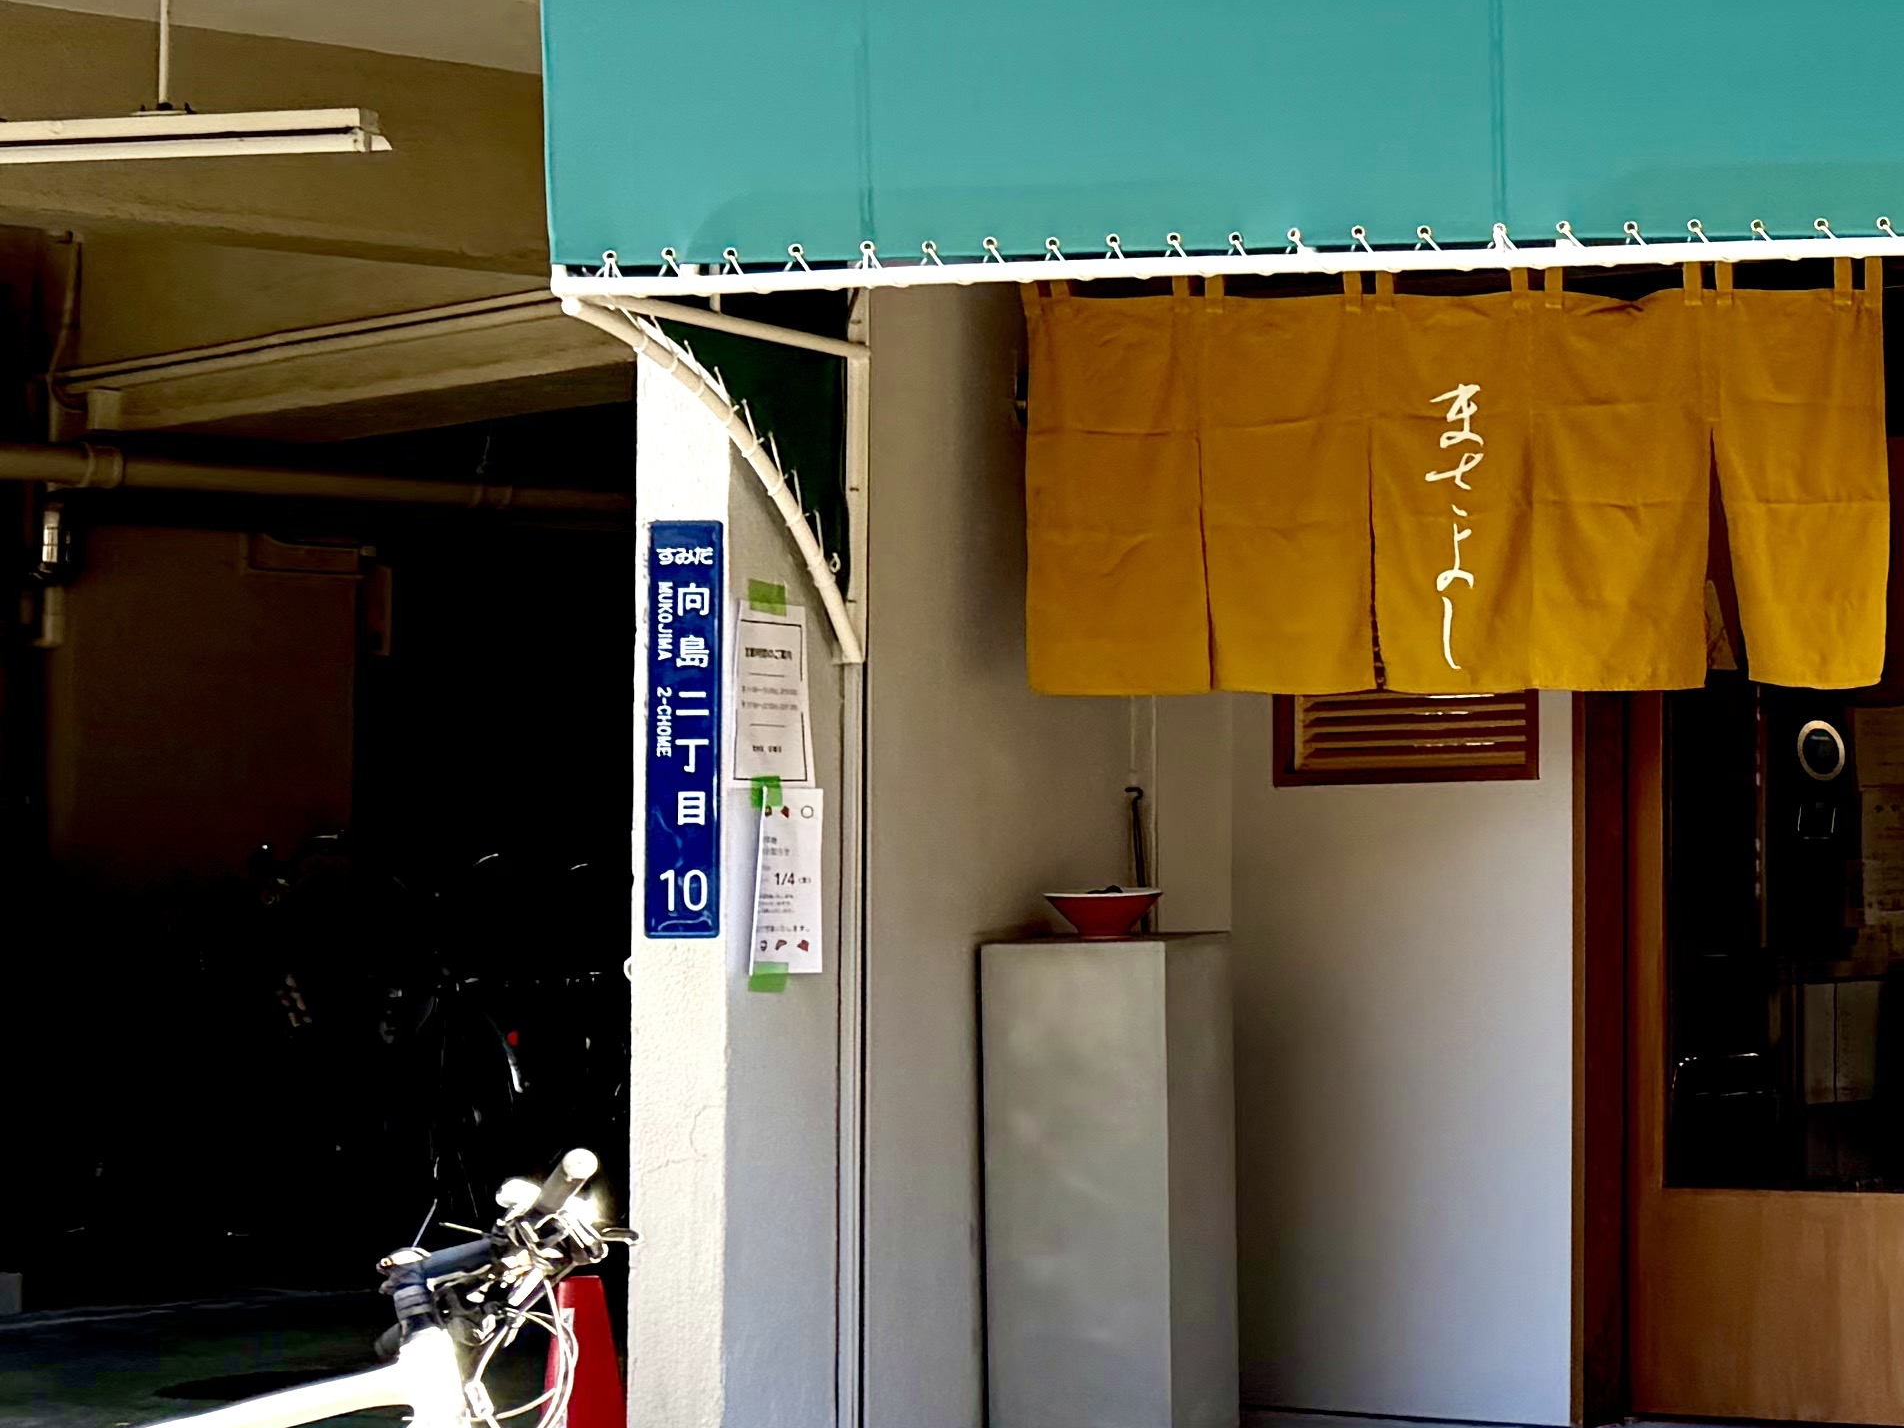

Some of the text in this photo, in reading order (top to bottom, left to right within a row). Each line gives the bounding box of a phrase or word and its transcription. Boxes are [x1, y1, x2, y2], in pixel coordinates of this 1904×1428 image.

[656, 547, 713, 565] すみだ
[1425, 384, 1484, 670] まさよし
[656, 582, 673, 757] MUKOJIMA 2-CHOME
[675, 583, 710, 825] 向島二丁目
[660, 870, 708, 911] 10
